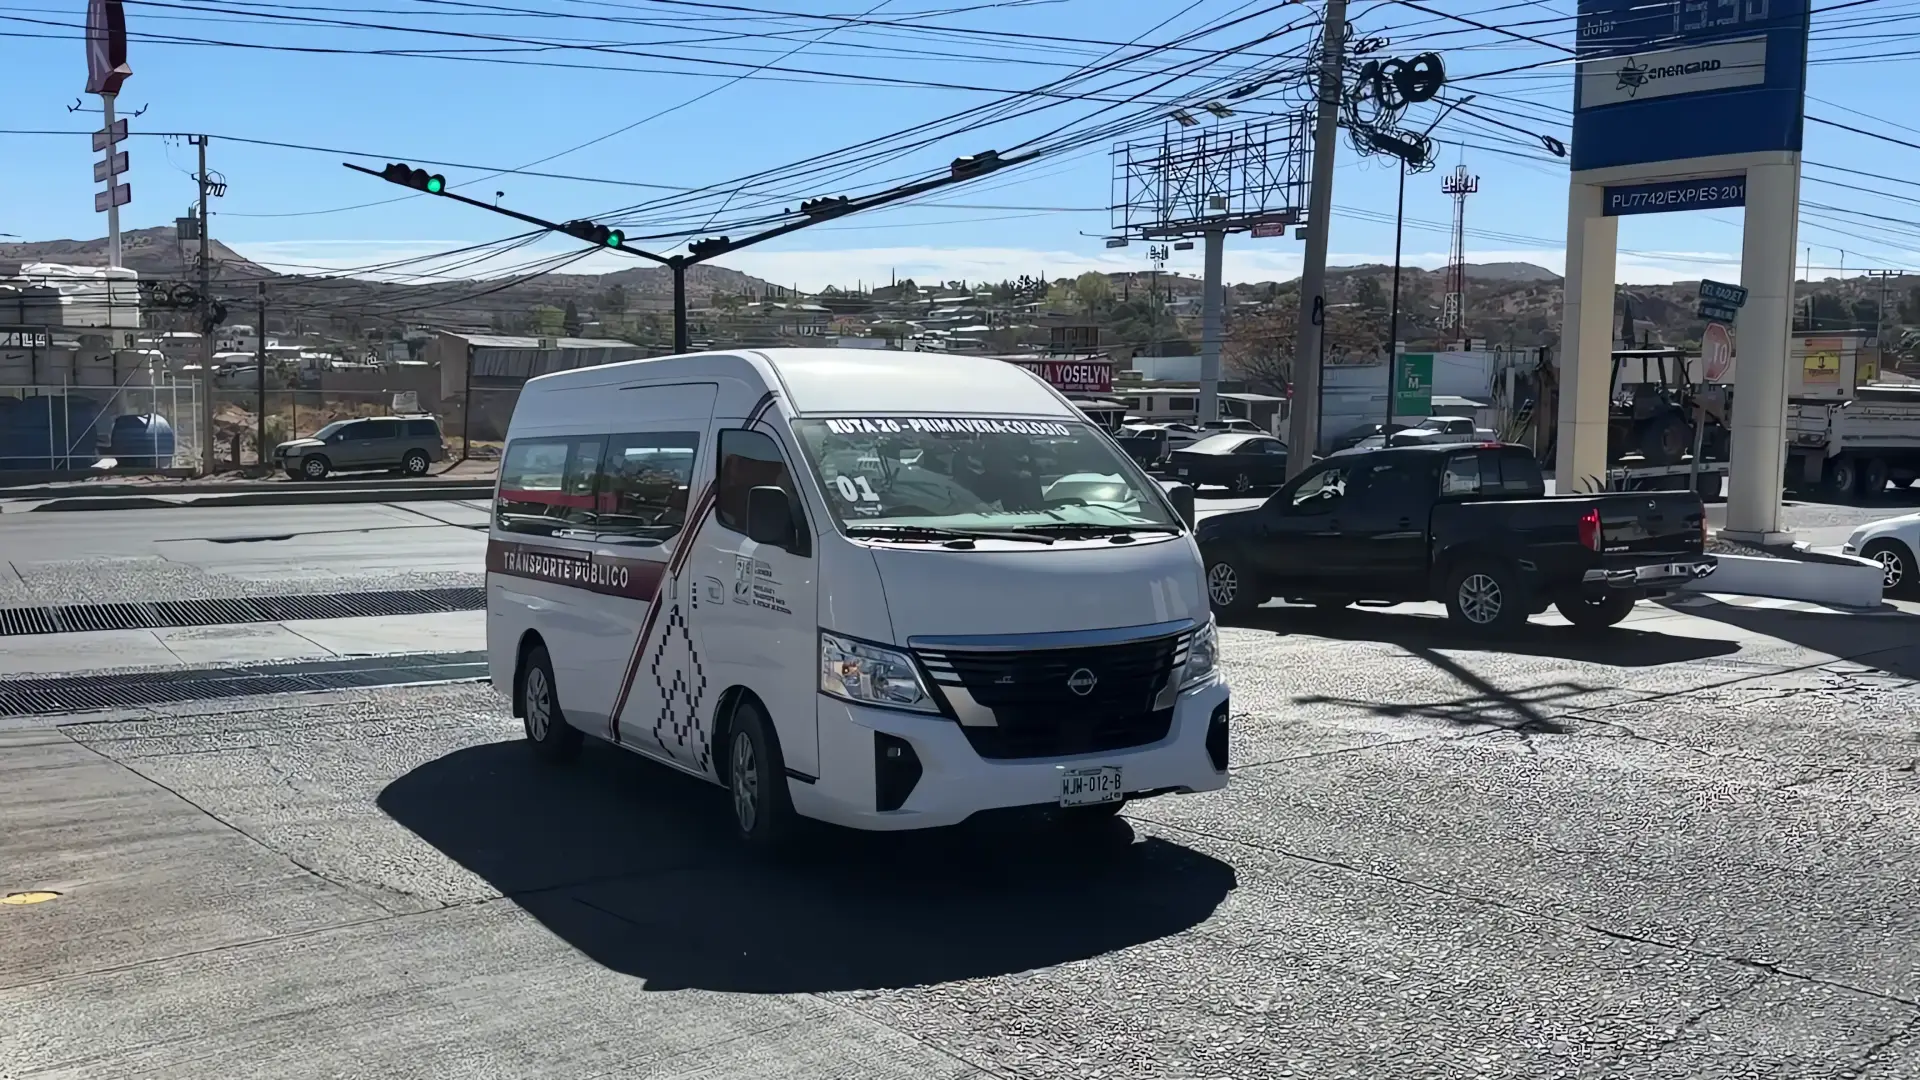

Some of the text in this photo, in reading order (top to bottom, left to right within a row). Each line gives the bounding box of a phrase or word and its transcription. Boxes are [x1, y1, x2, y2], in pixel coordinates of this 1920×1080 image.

[1055, 364, 1110, 384] YOSELYN
[825, 418, 880, 434] RUTA
[874, 418, 901, 433] 20
[836, 475, 880, 502] 01
[575, 556, 629, 588] PÚBLICO
